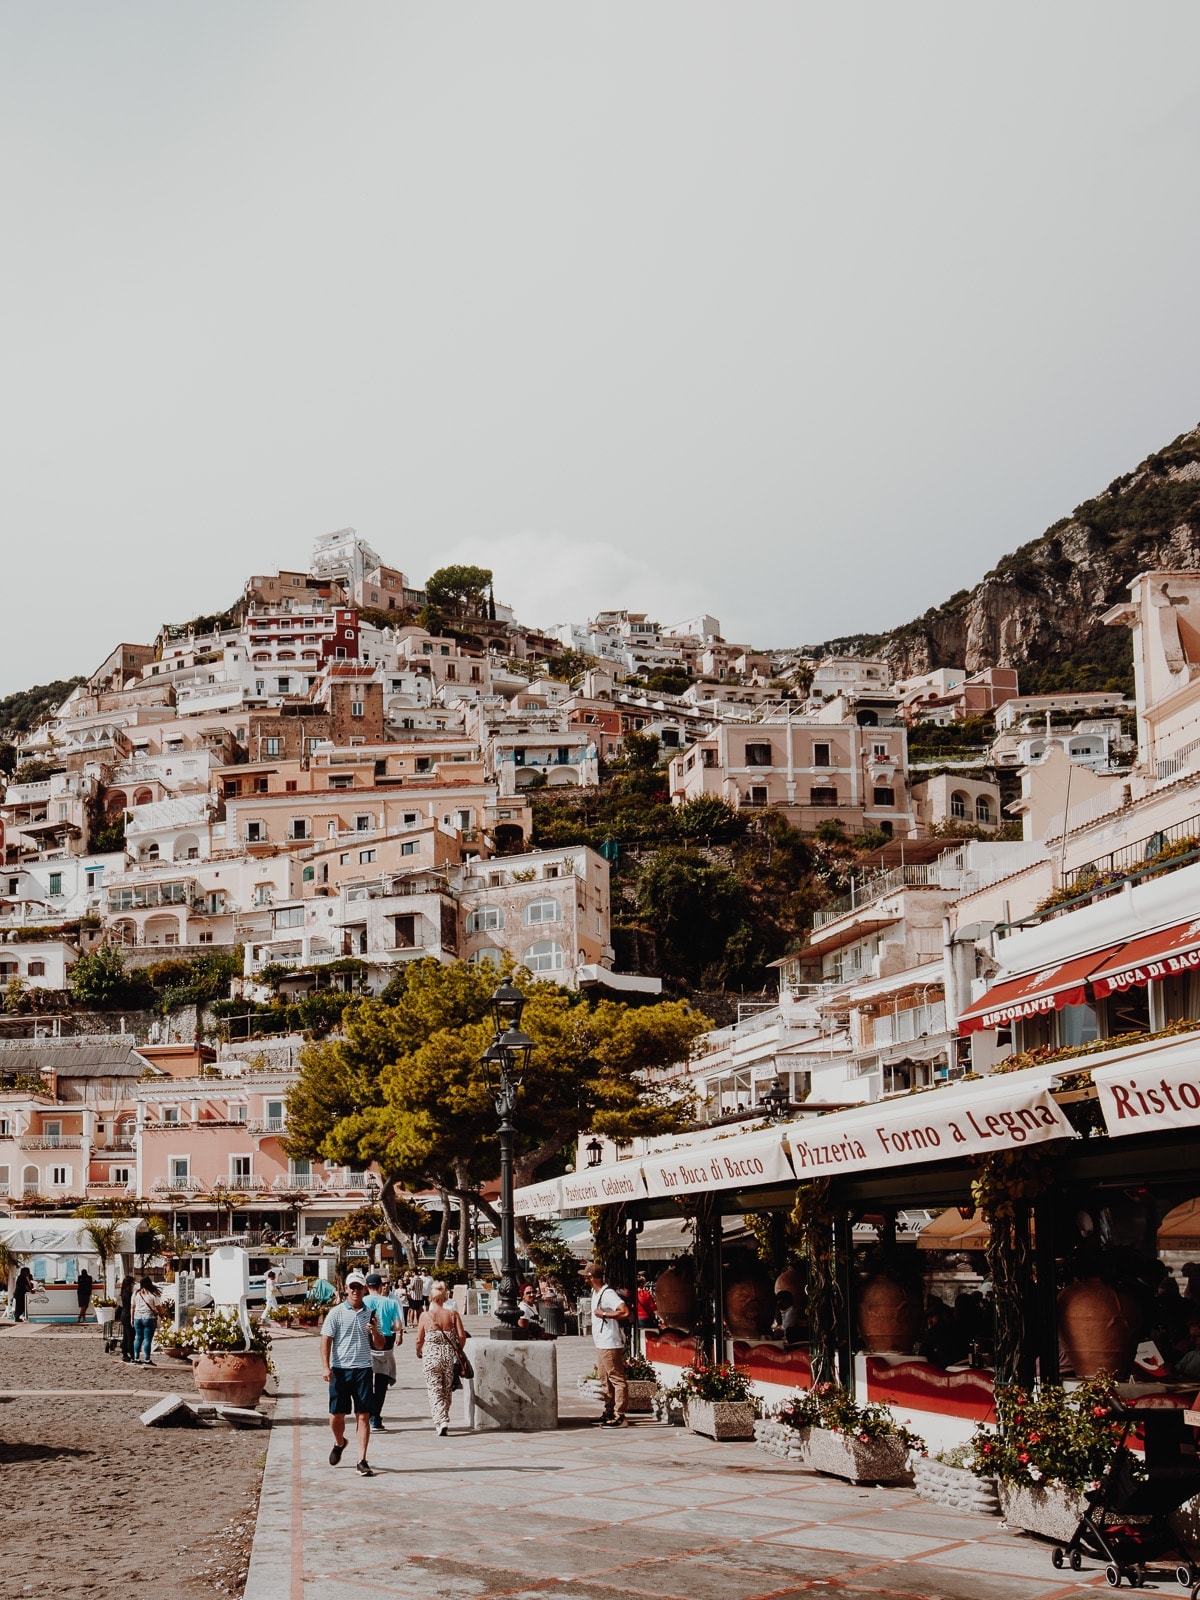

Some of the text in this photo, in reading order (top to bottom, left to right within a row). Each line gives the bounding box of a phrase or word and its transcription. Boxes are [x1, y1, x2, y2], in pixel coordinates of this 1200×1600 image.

[1107, 968, 1147, 990] BUCA
[1147, 961, 1165, 978] DI
[982, 995, 1055, 1027] RISTORANTE
[1110, 1079, 1200, 1119] Risto
[796, 1104, 1059, 1167] Pizzeria Forno a Legna
[565, 1173, 634, 1202] Pasticceria Gelateria
[660, 1156, 764, 1188] Bar Buca di Bacco
